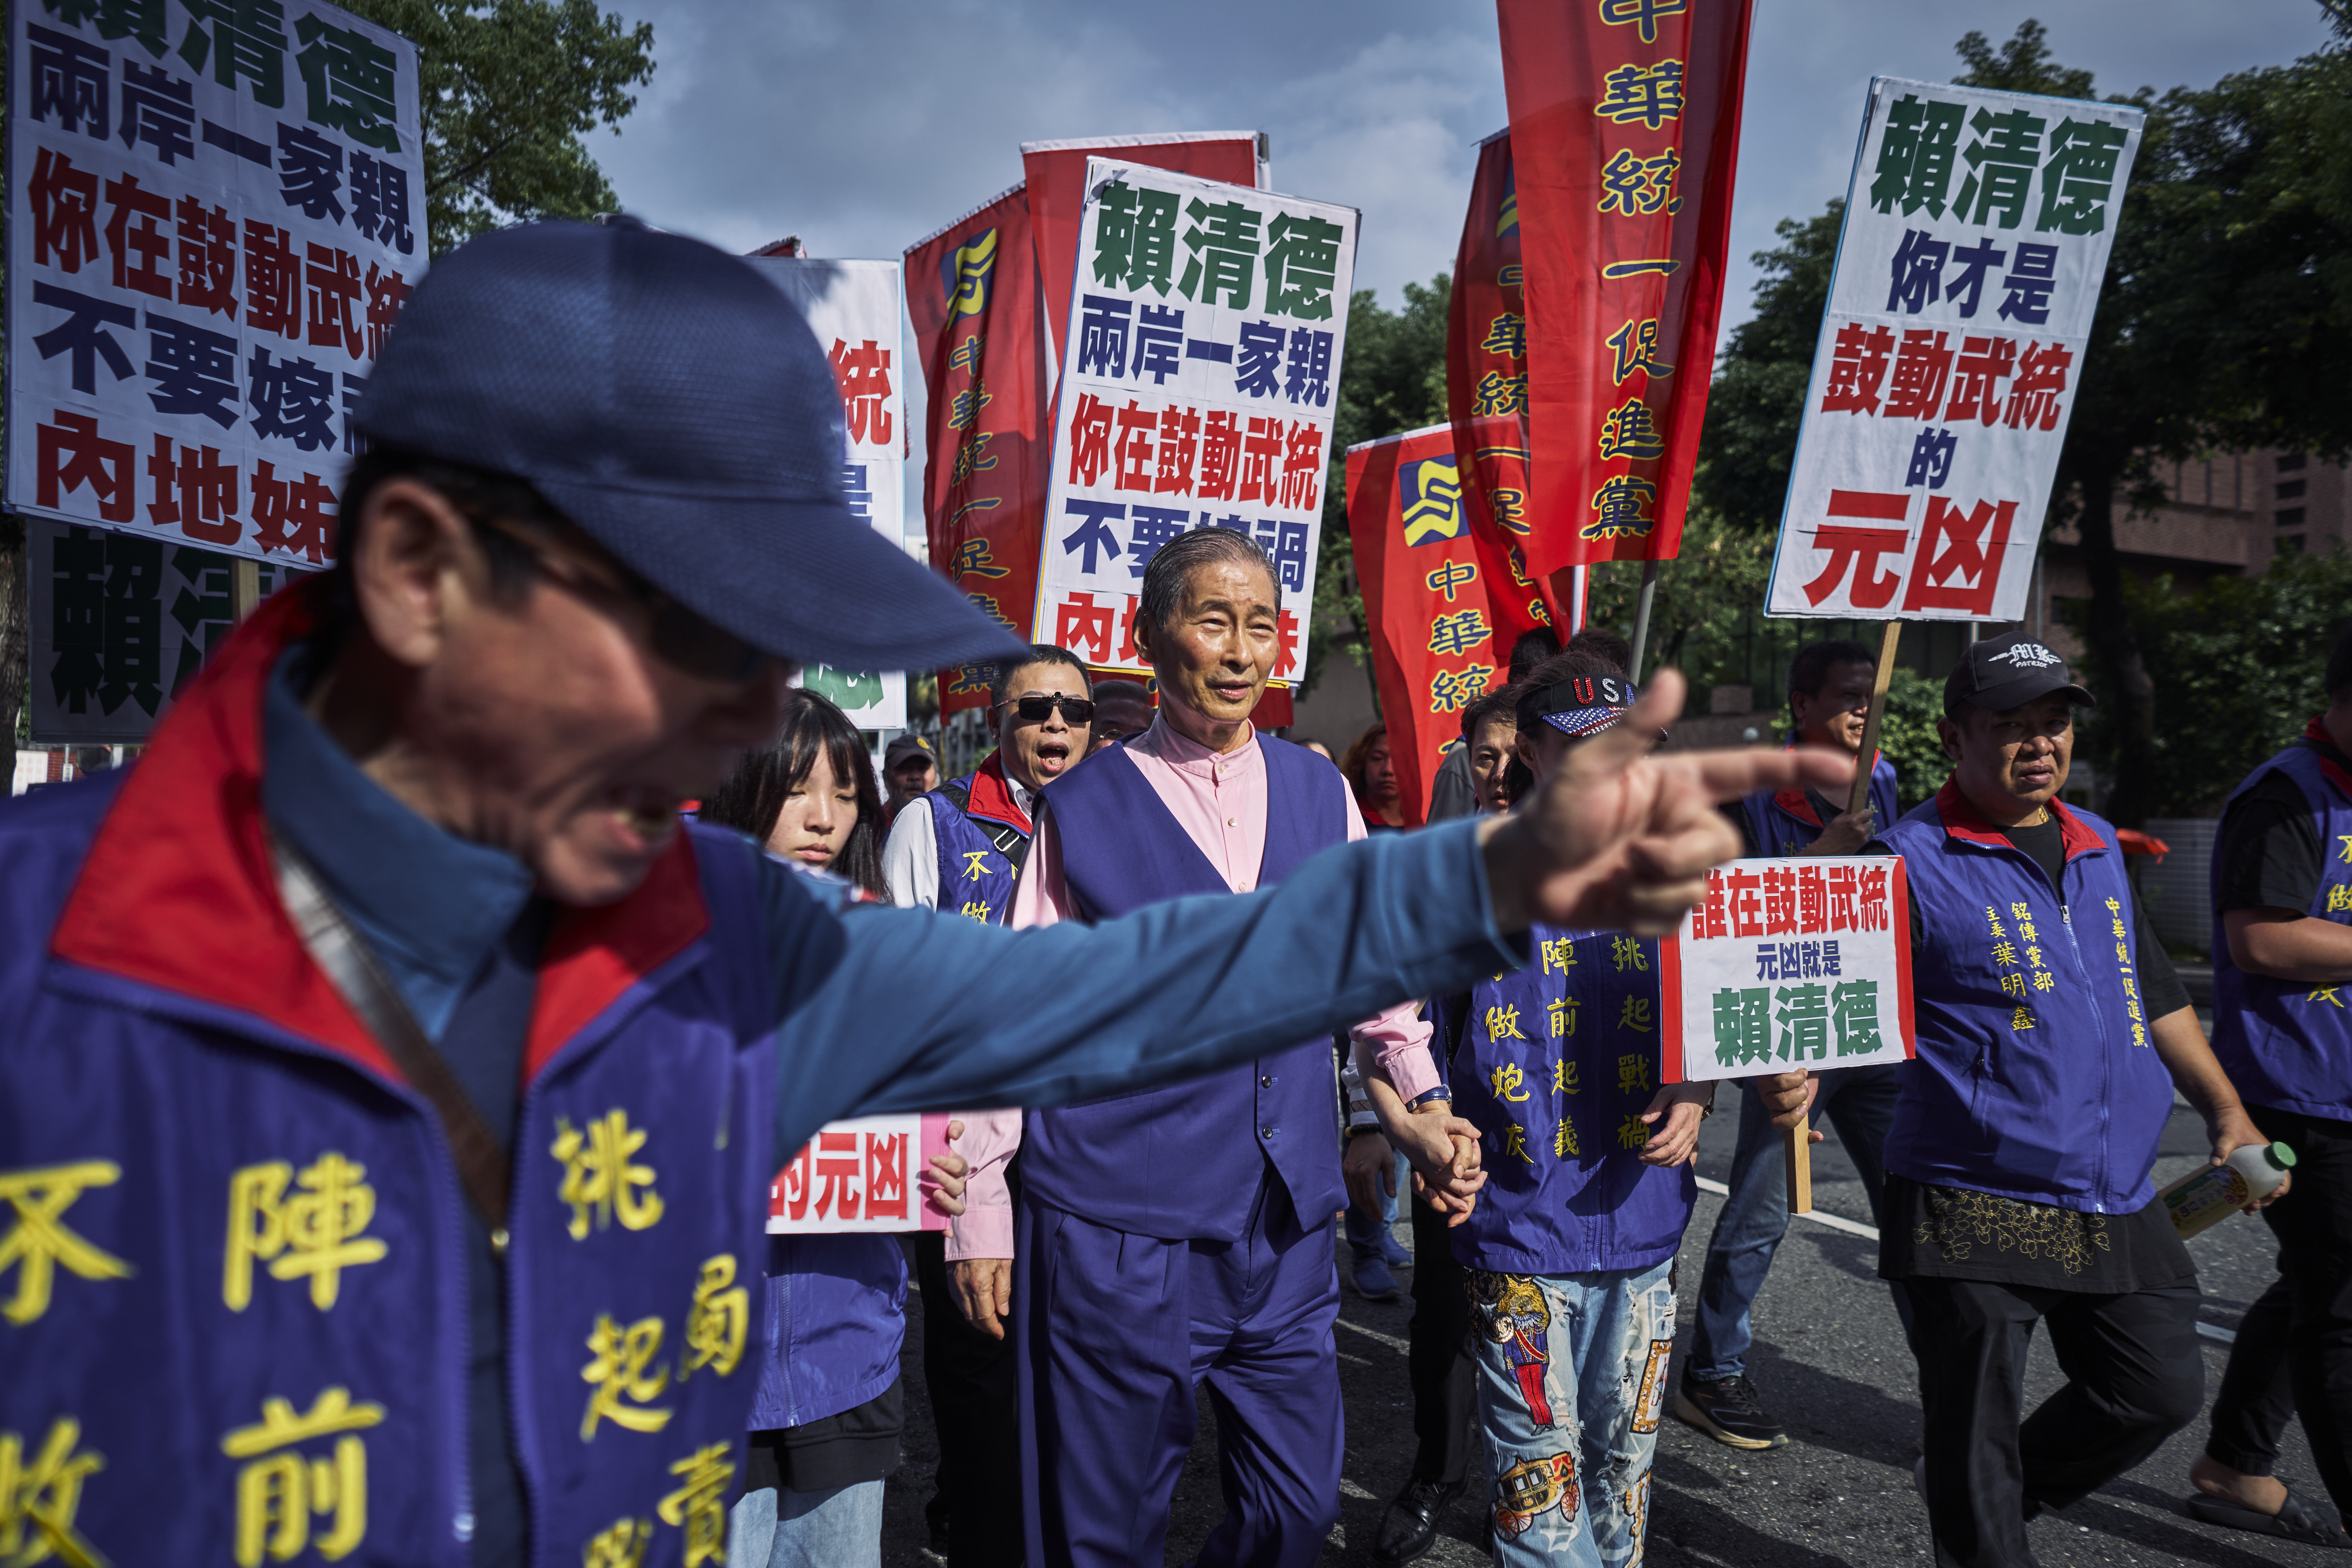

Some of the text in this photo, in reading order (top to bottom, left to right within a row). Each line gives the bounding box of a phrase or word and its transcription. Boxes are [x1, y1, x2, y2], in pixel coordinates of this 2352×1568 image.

[27, 21, 414, 255] 兩岸一家親
[1869, 93, 2129, 237] 賴清德
[1093, 180, 1344, 322] 賴清德
[1580, 0, 1686, 541] 中華統一促進黨
[1886, 228, 2059, 325] 你才是
[32, 279, 369, 456] 不要嫁
[1077, 293, 1334, 407] 兩岸一家親
[1820, 322, 2073, 432] 鼓動武統
[1068, 392, 1323, 511] 你在鼓動武統
[1905, 426, 1958, 489] 的
[1062, 497, 1309, 593] 不要禍
[1802, 489, 2020, 616] 元凶
[1756, 940, 1842, 981] 元凶就是
[2011, 901, 2054, 993] 銘傳黨部
[2105, 896, 2149, 1048] 中華統一促進黨
[1485, 966, 1535, 1164] 做炮灰
[1541, 937, 1581, 1158] 陣前起義
[1712, 978, 1883, 1068] 賴清德
[221, 1150, 389, 1568] 陣前
